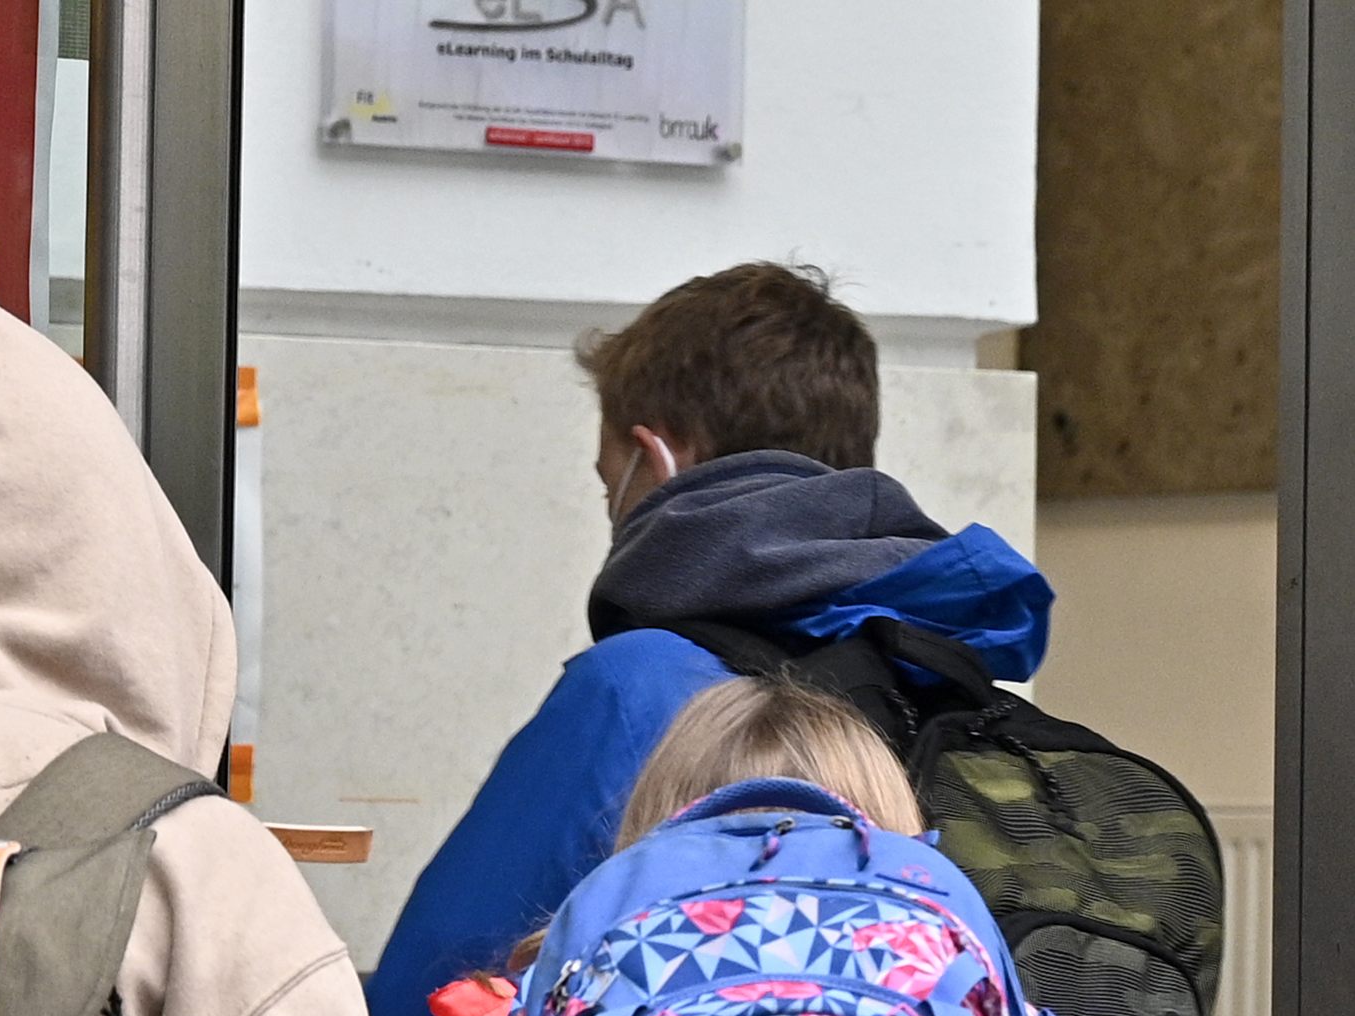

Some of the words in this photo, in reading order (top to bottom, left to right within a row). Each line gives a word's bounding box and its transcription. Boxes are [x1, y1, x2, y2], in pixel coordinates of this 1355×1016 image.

[436, 41, 517, 63] eLearning
[521, 44, 542, 60] im
[545, 46, 634, 71] Schulalltag
